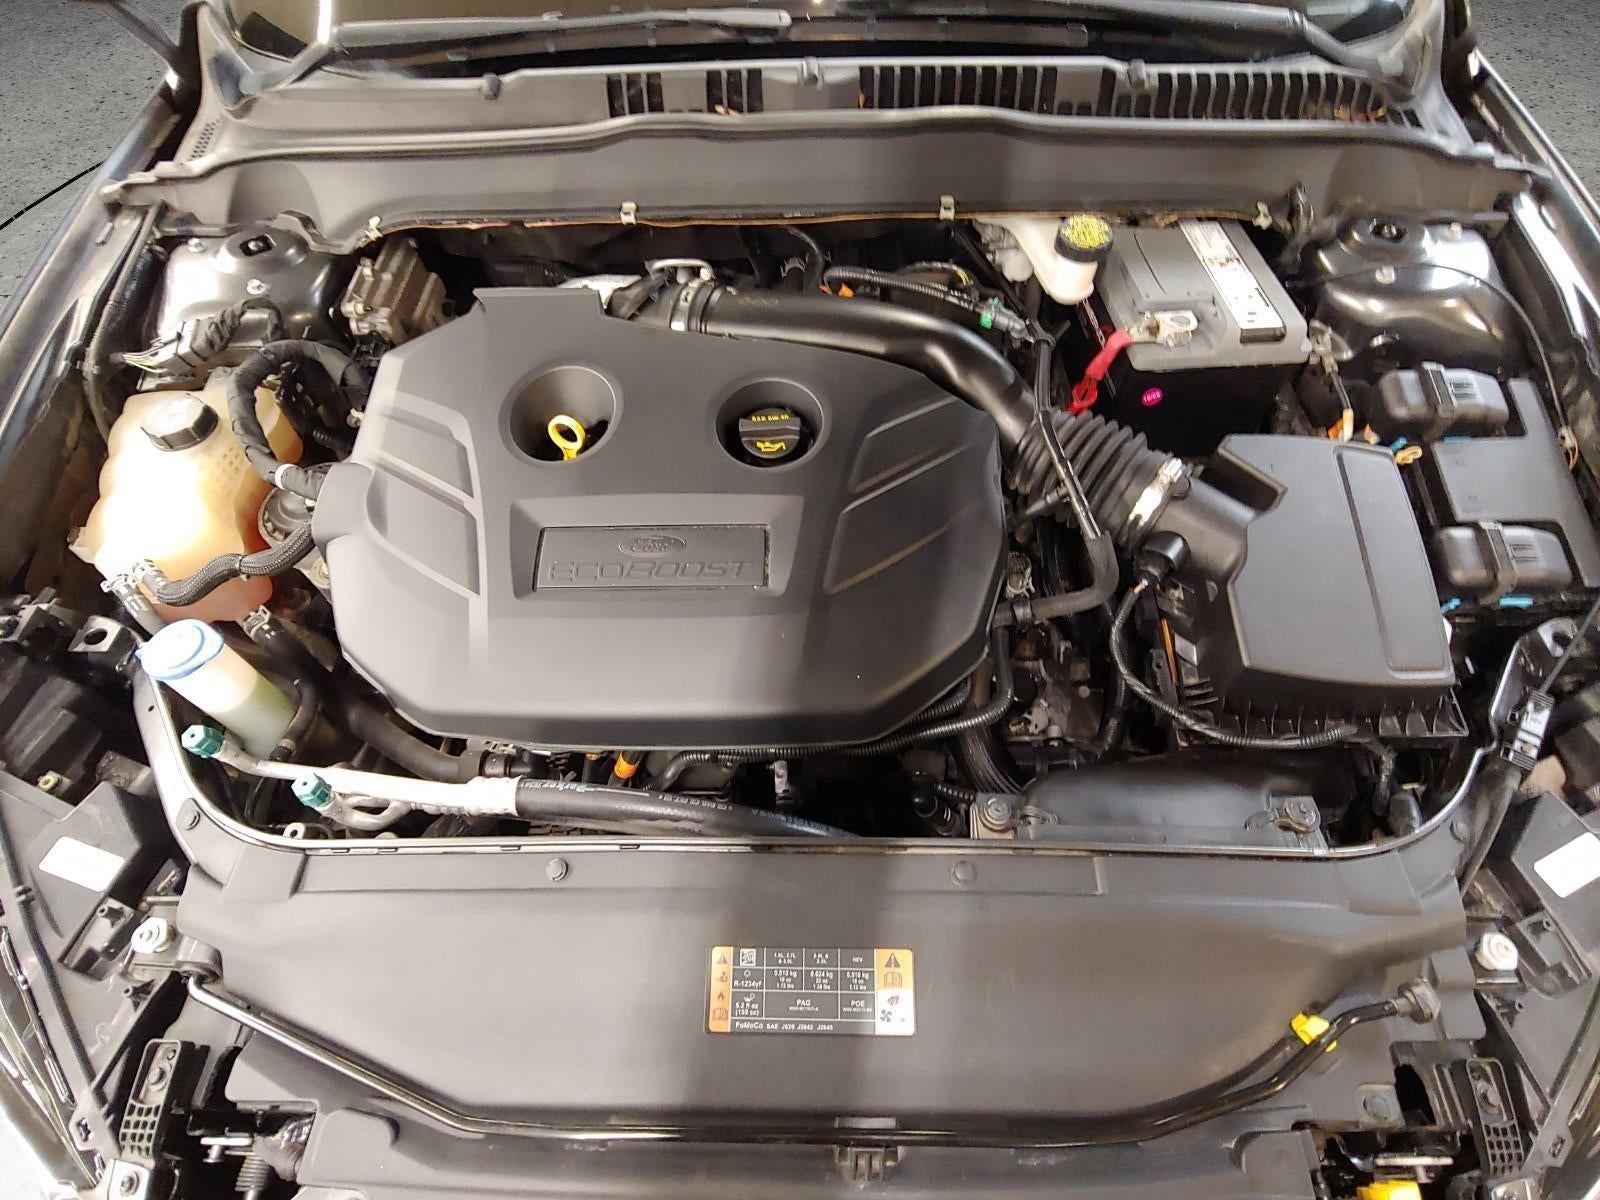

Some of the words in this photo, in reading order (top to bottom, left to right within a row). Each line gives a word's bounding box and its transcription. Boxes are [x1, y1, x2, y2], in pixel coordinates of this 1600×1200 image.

[789, 970, 797, 978] kg
[826, 971, 834, 979] kg
[733, 980, 762, 989] R-1234yf
[796, 999, 811, 1007] PAG
[735, 1021, 763, 1029] FoMoCo
